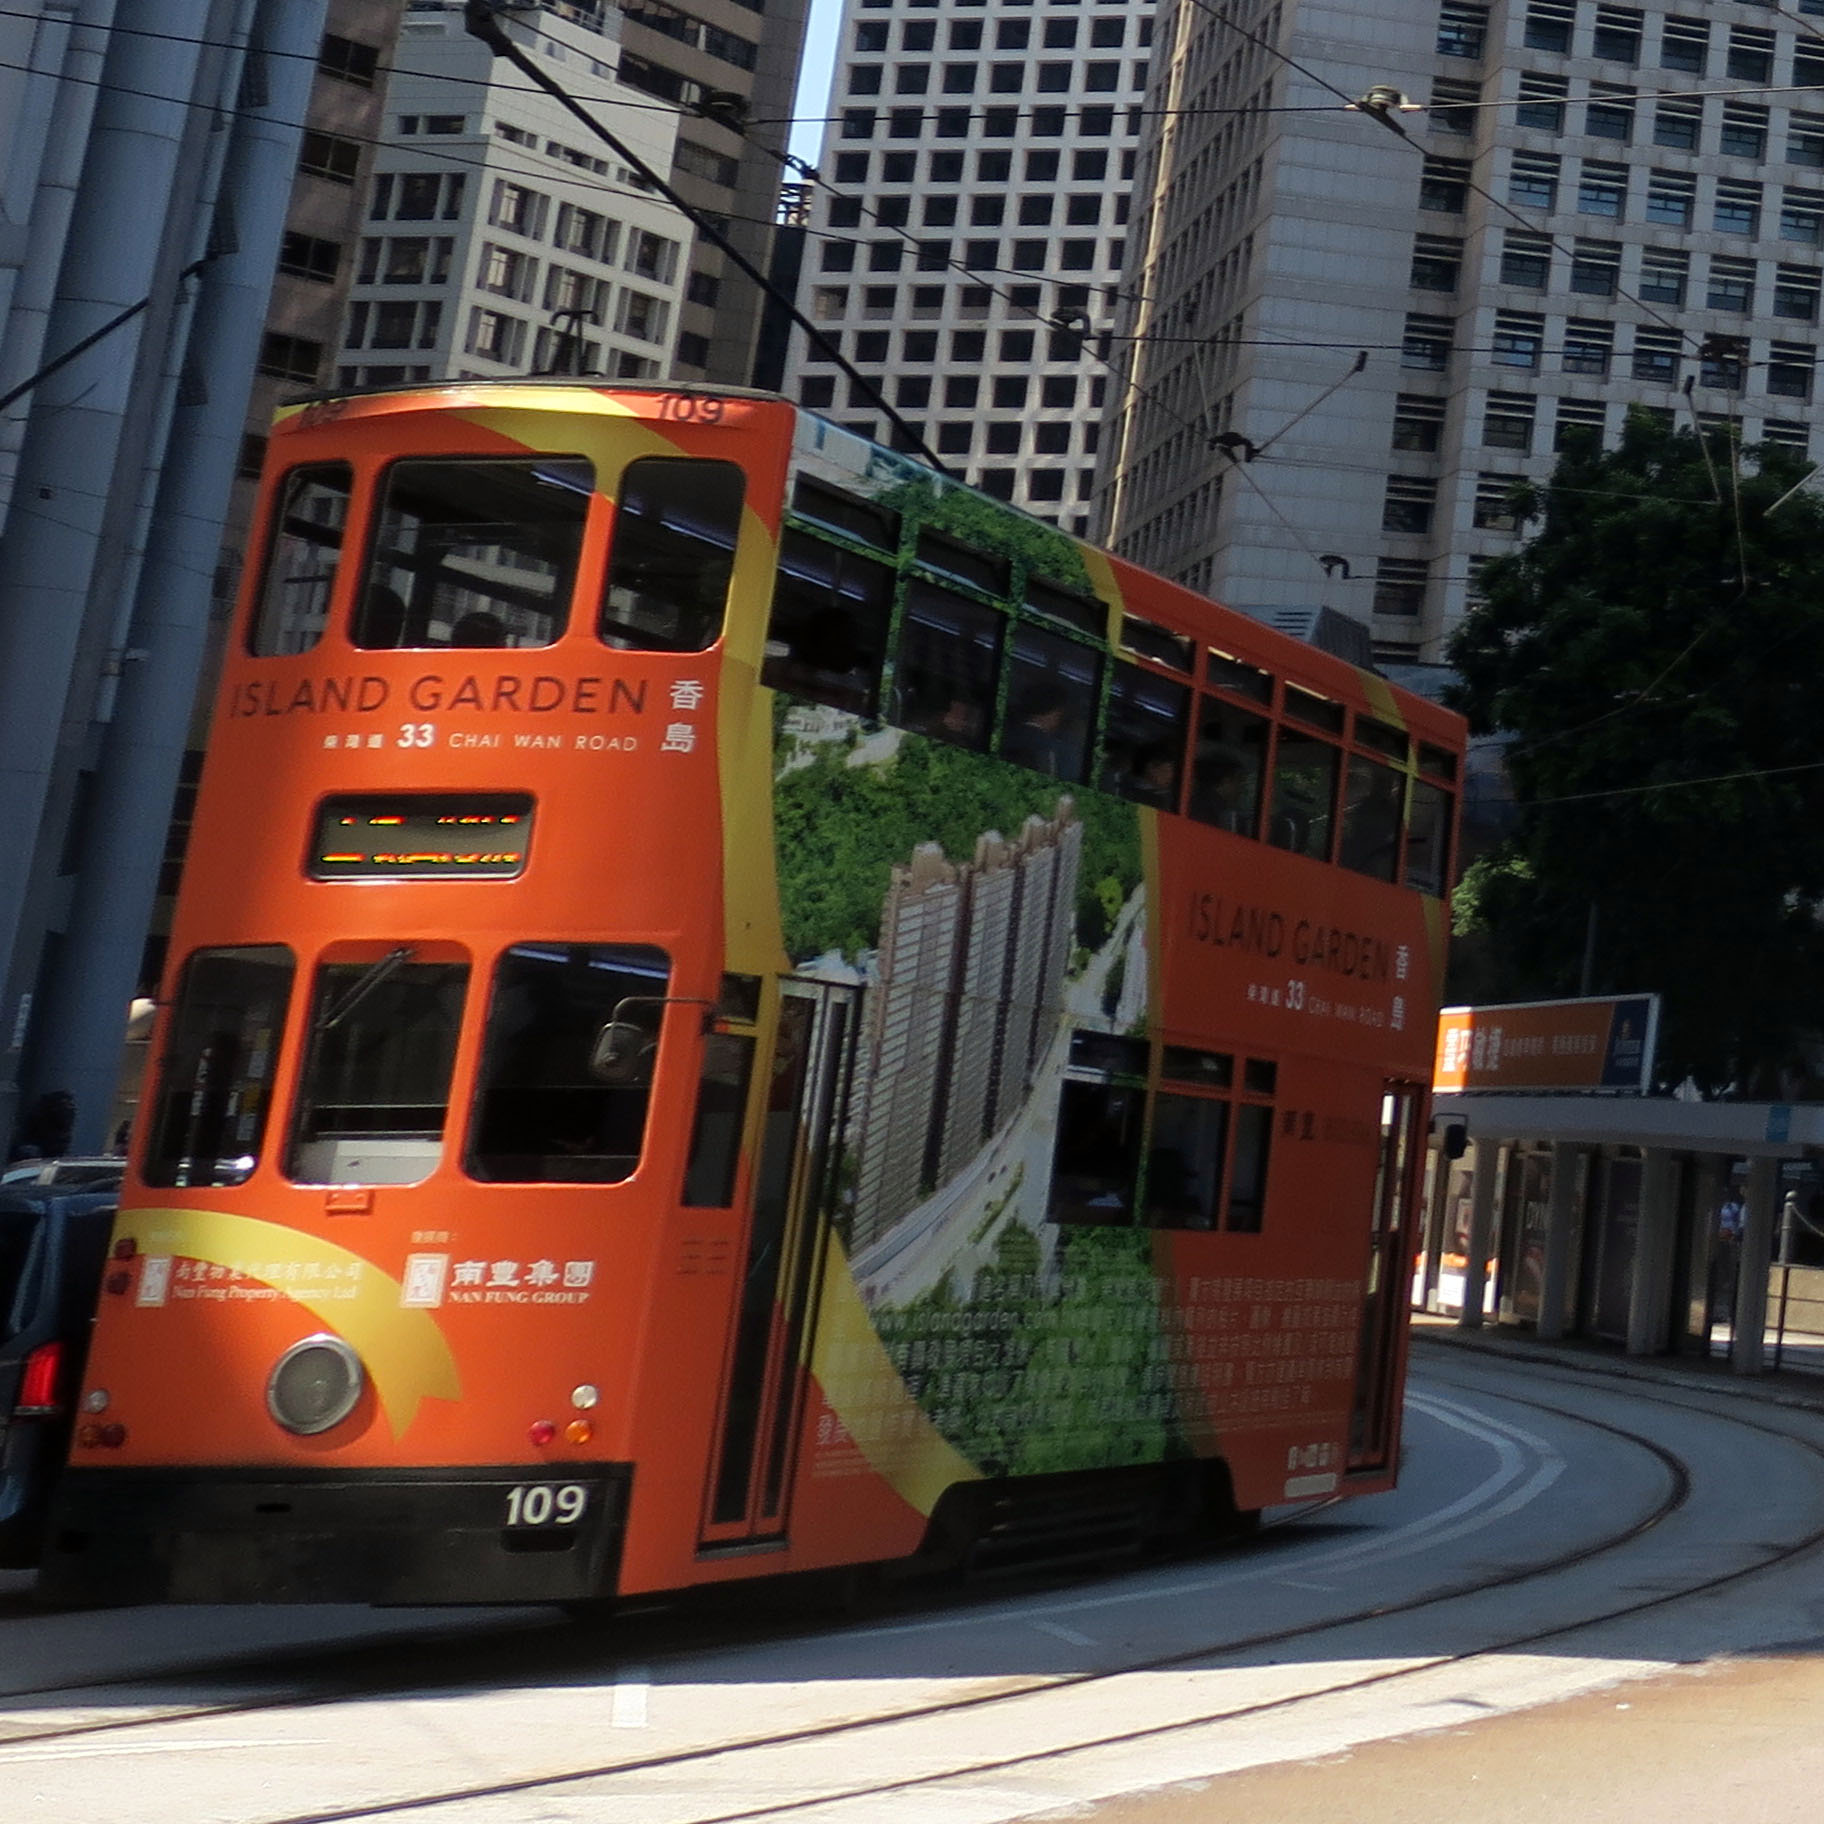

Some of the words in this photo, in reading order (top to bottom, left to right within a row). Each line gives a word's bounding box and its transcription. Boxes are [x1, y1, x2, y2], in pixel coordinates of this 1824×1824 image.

[658, 393, 724, 424] 109
[229, 676, 391, 718] ISLAND
[410, 675, 648, 715] GARDEN
[660, 679, 704, 754] 香島
[397, 723, 435, 748] 33
[449, 732, 500, 749] CHAI
[513, 734, 562, 750] WAN
[574, 735, 638, 752] ROAD
[1189, 892, 1284, 956] ISLAND
[1294, 918, 1391, 983] GARDEN
[1285, 979, 1304, 1011] 33
[450, 1259, 595, 1288] 南豐集團
[448, 1291, 482, 1304] NAN
[484, 1291, 529, 1304] FUNG
[532, 1291, 590, 1305] GROUP
[506, 1485, 586, 1526] 109
